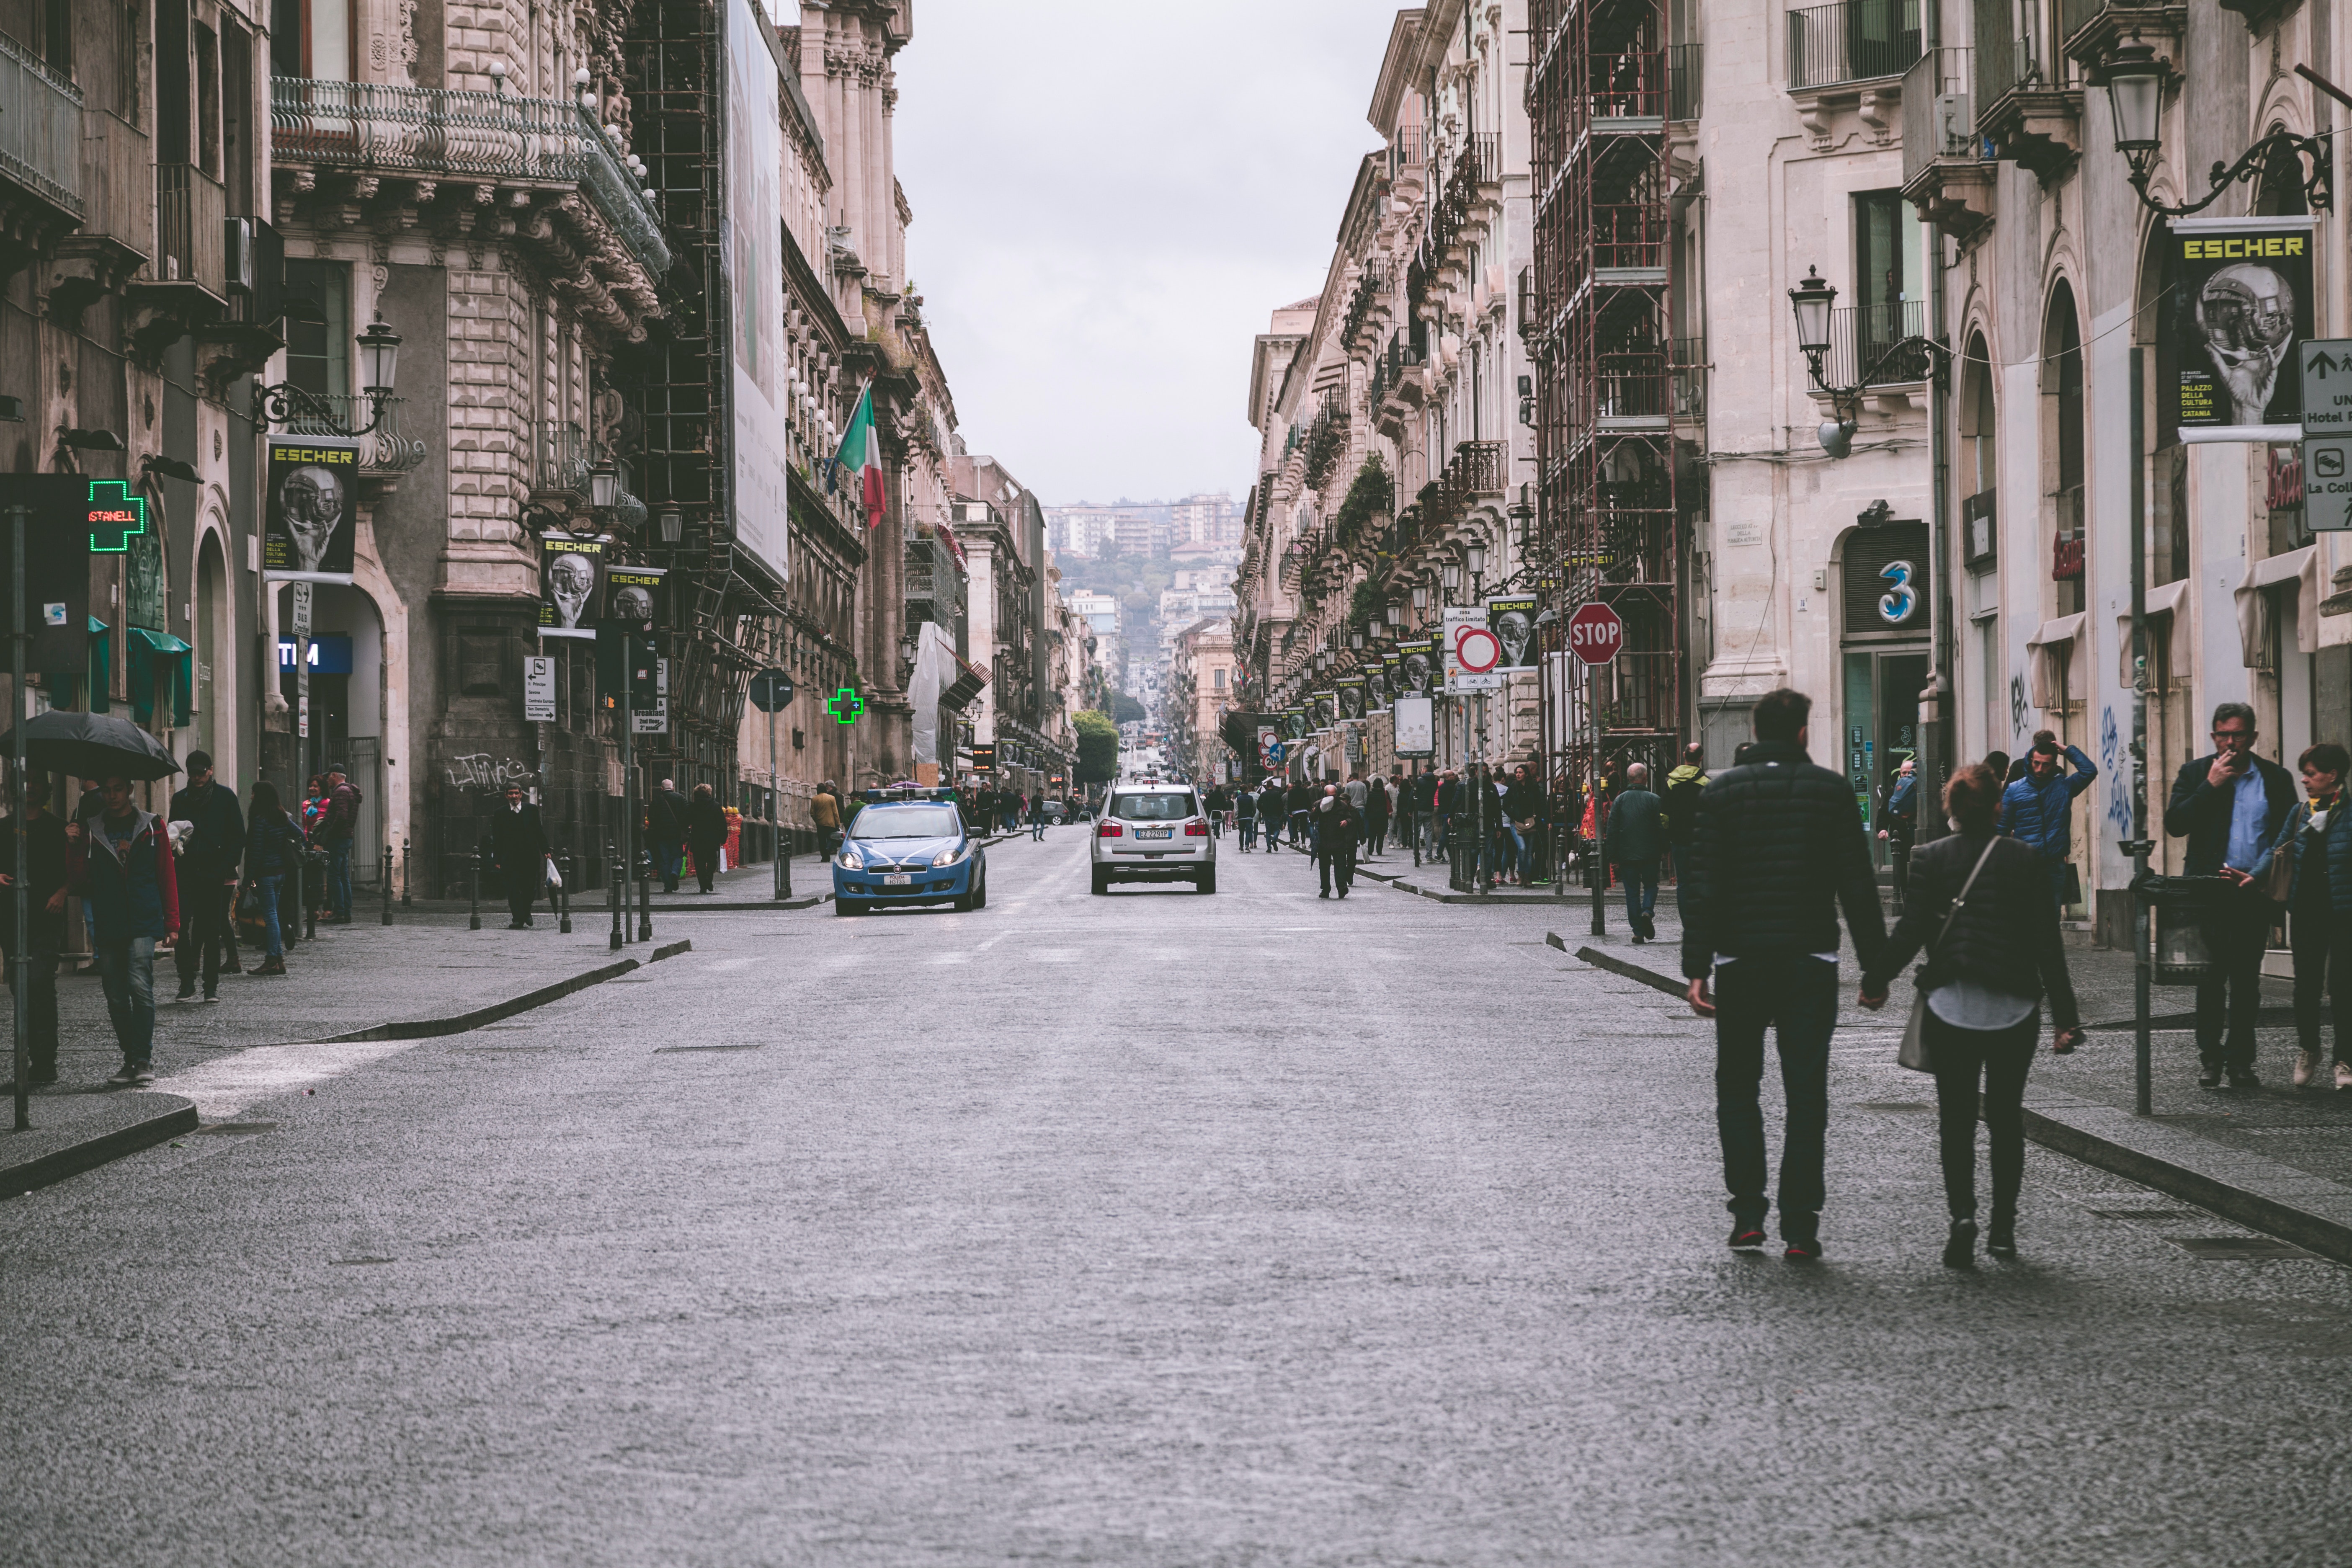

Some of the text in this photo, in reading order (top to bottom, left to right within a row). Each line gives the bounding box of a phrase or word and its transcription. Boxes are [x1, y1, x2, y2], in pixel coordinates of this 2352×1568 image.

[2184, 237, 2303, 258] ESCHER
[2308, 411, 2343, 423] Hotel
[275, 449, 353, 464] ESCHER
[2308, 482, 2323, 493] La
[546, 541, 601, 553] ESCHER
[611, 575, 660, 585] ESCHER
[1879, 560, 1917, 624] 3
[1492, 602, 1534, 611] ESCHER
[294, 623, 310, 634] Crociferi
[1573, 622, 1618, 645] STOP
